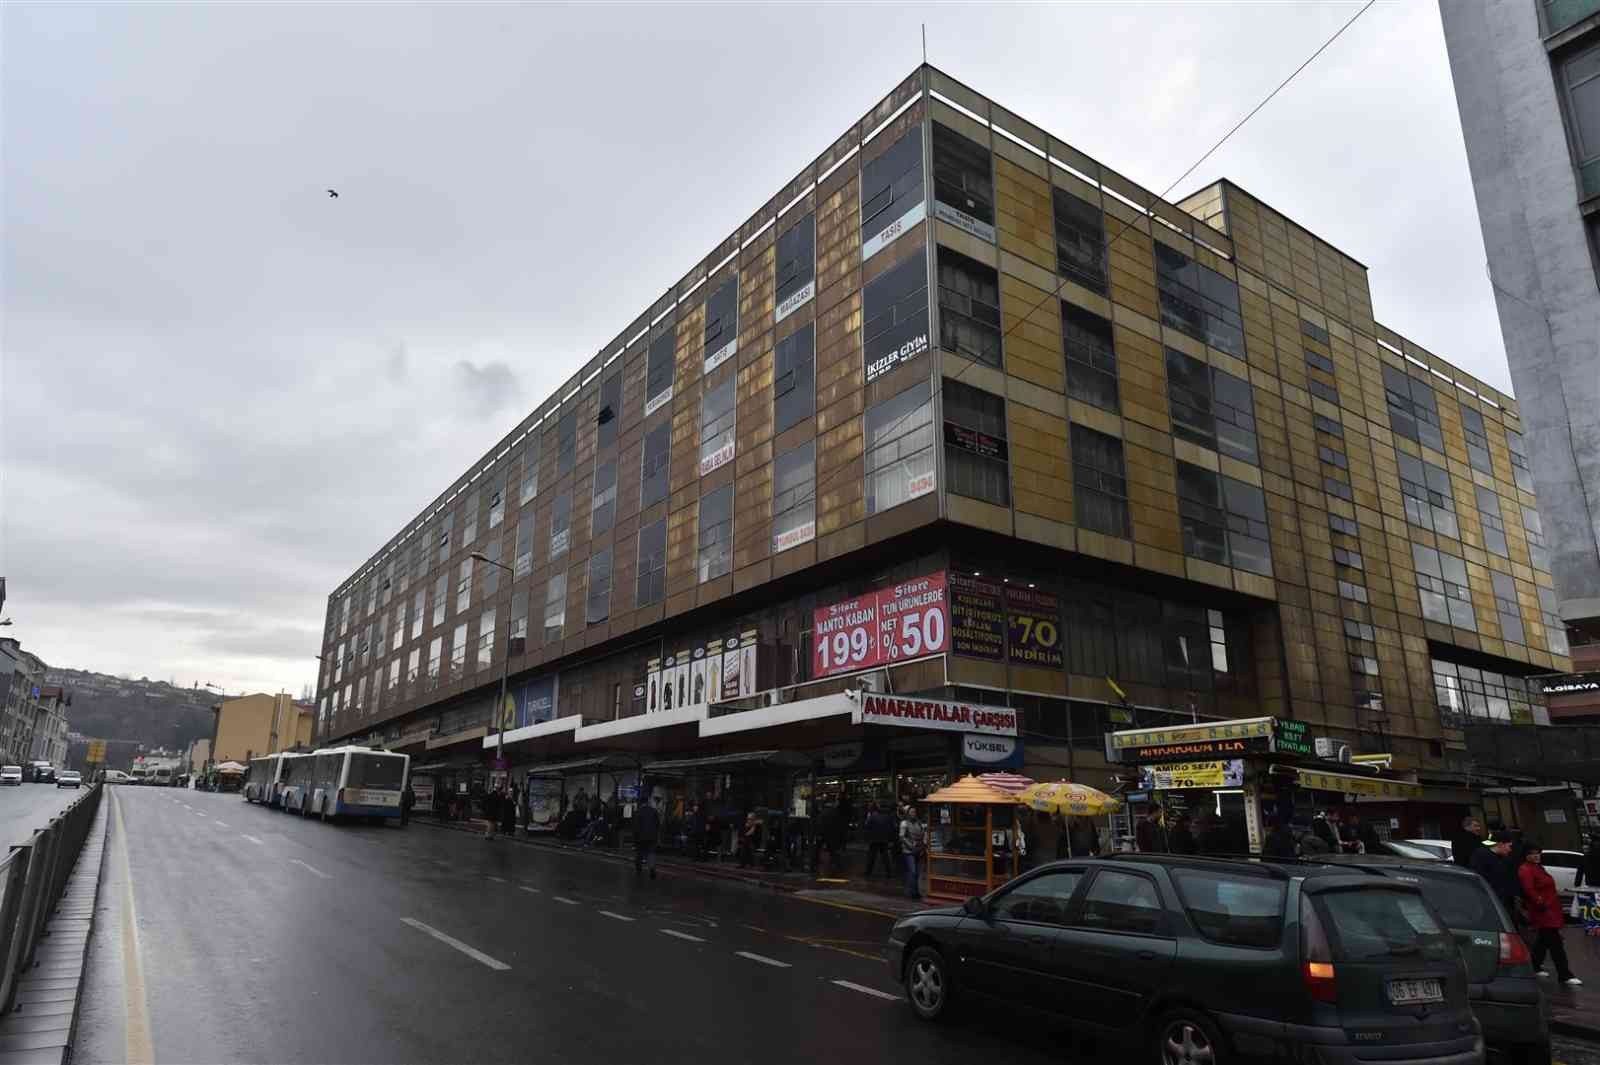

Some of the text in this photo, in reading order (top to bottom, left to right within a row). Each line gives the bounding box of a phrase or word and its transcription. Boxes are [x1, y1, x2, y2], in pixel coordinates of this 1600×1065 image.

[846, 607, 874, 627] KABAN
[881, 618, 898, 632] NET
[818, 627, 868, 668] 199
[864, 696, 1015, 731] ANAFARTALAR ÇARŞISI
[967, 740, 1009, 753] YÜKSEL
